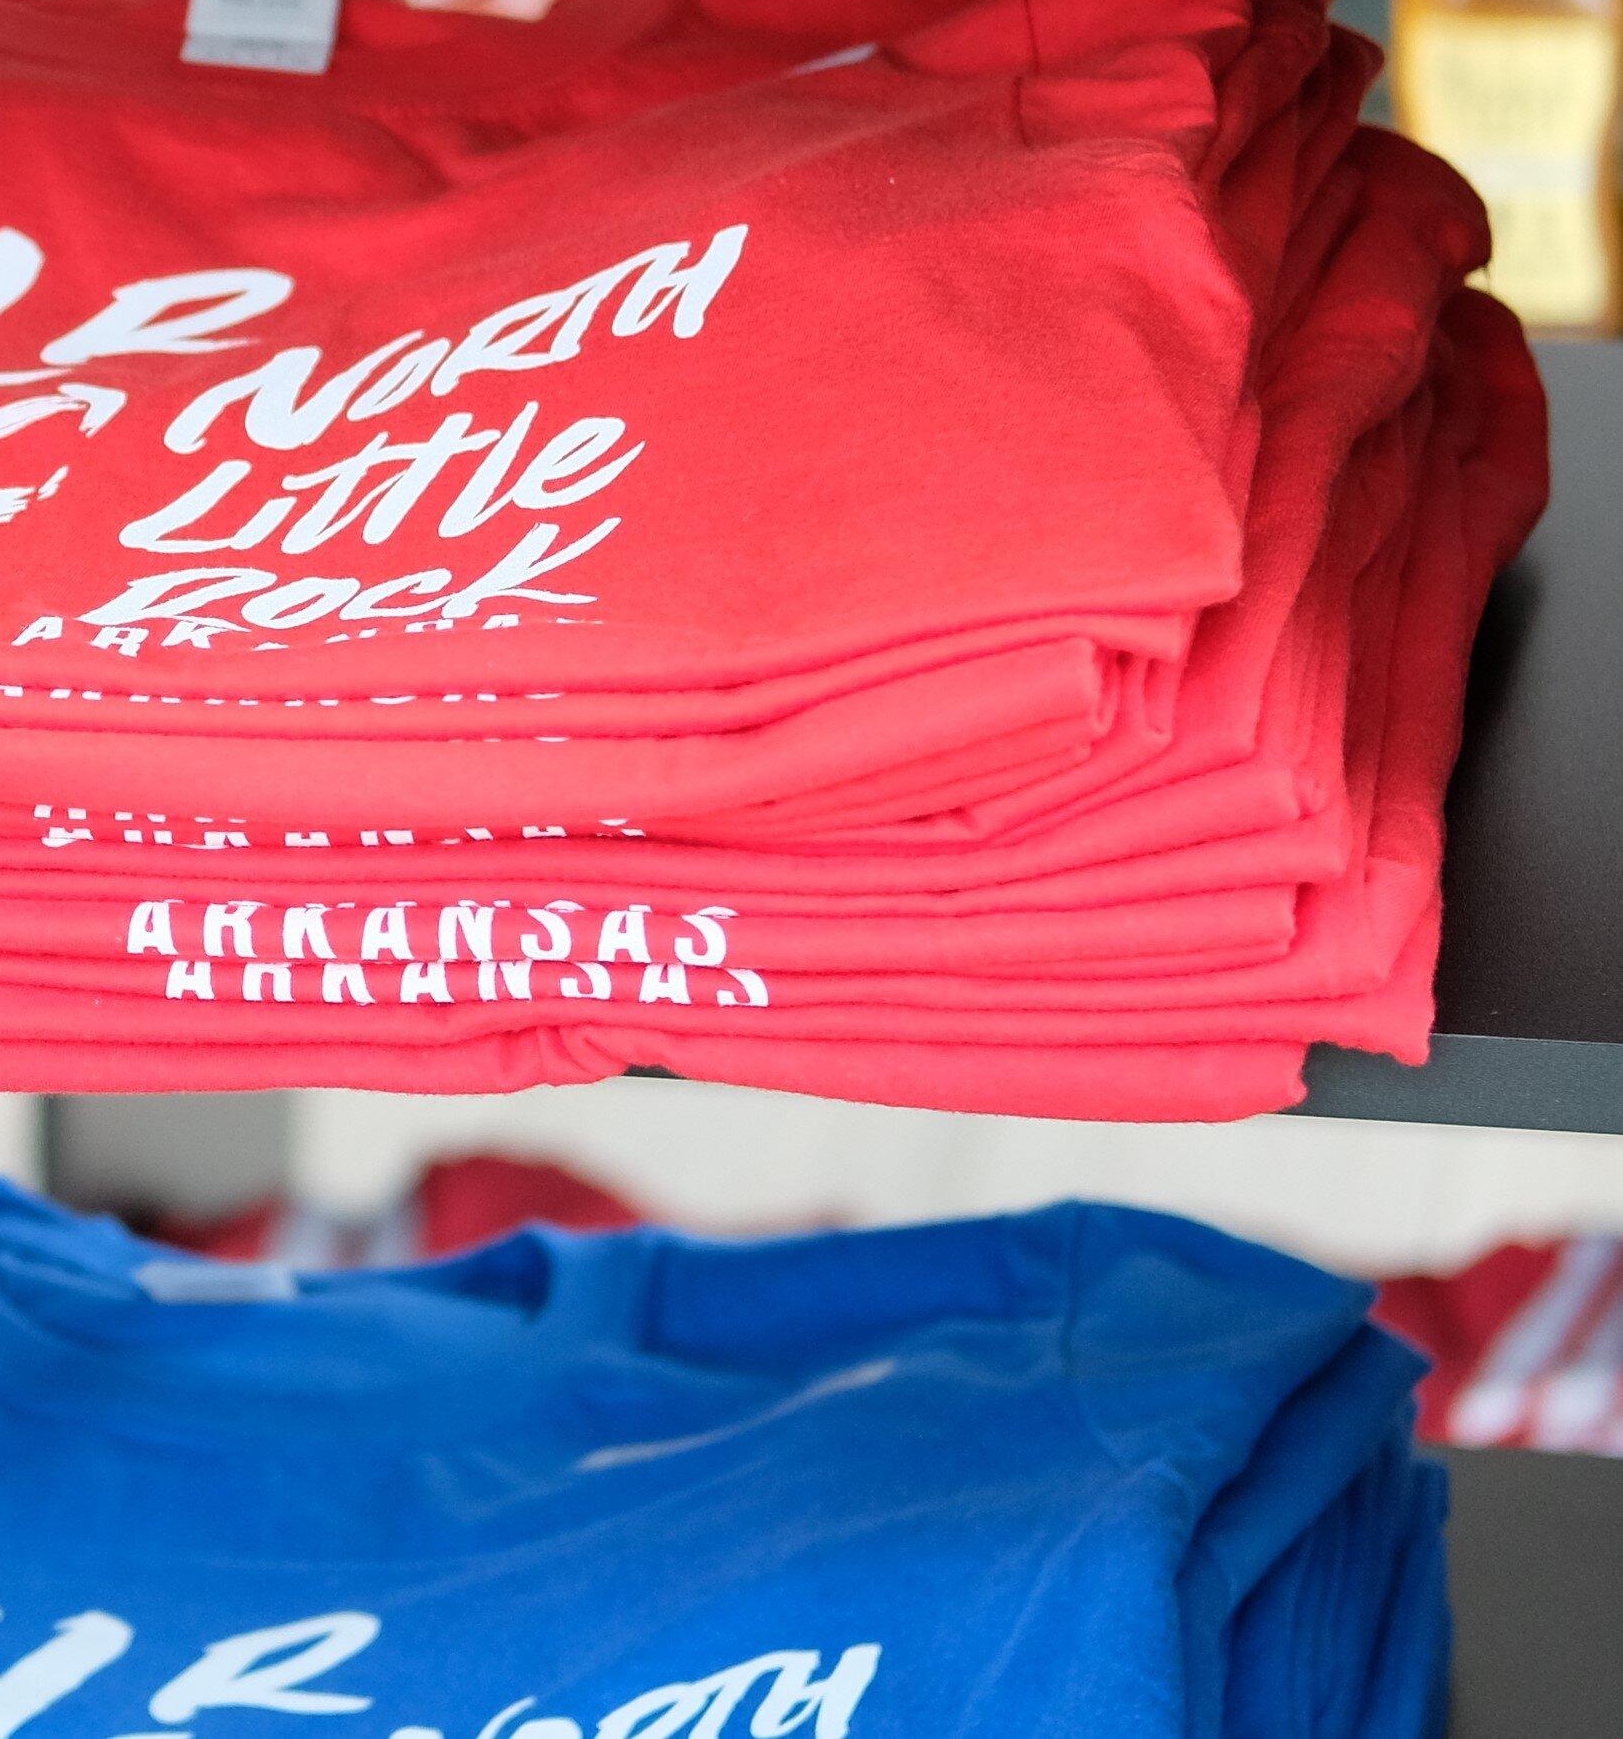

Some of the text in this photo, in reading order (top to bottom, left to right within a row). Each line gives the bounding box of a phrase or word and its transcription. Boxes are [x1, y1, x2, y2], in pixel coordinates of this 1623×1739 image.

[163, 223, 750, 454] NORTH
[126, 901, 729, 966] ARKANSAS
[165, 960, 769, 1008] ARKANSAS
